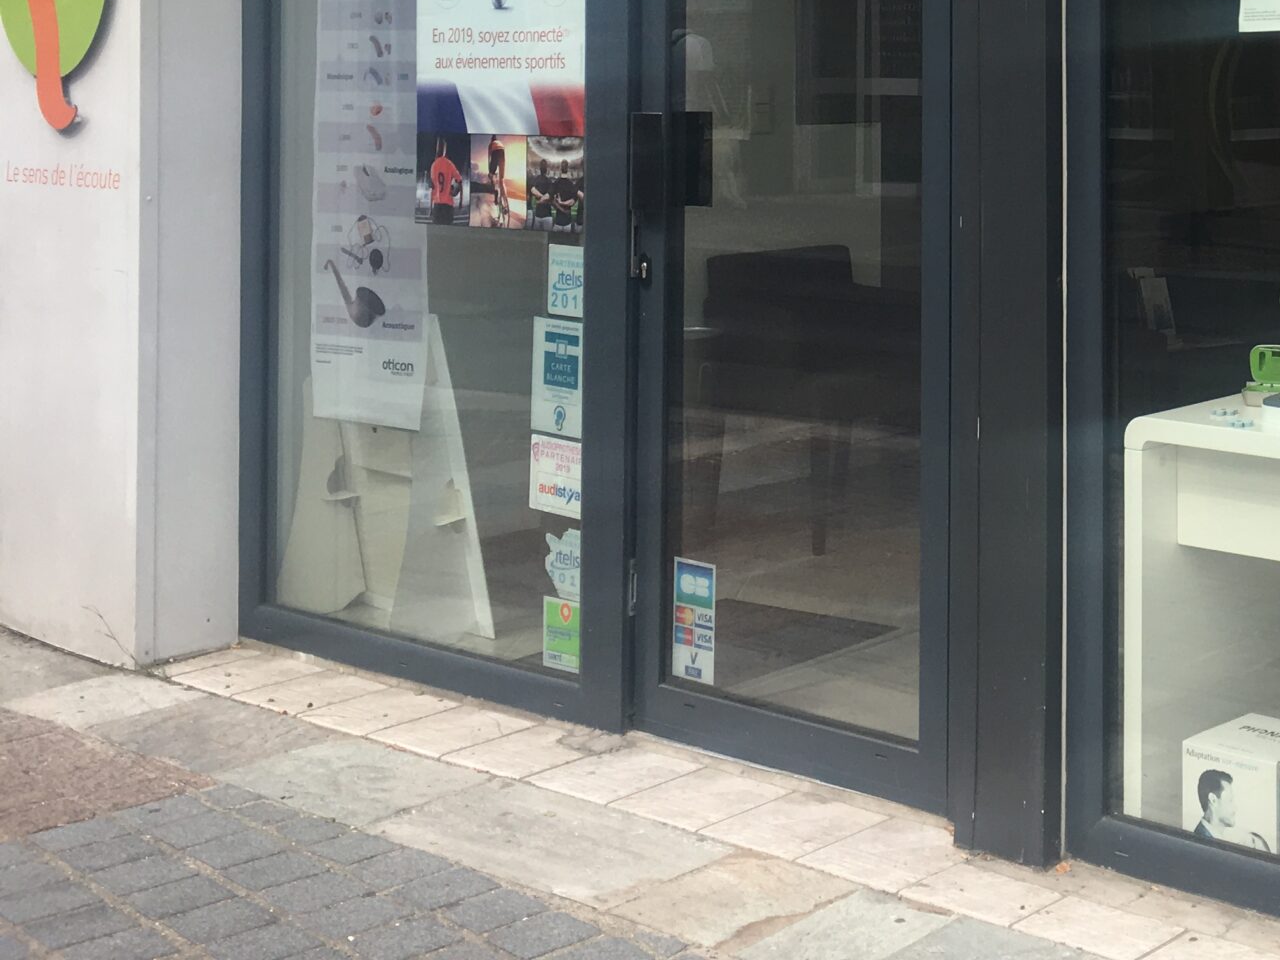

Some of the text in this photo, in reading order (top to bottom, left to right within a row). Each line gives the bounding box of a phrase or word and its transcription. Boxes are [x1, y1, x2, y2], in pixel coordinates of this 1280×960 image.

[432, 25, 563, 47] En 2019, soyez connecté
[435, 52, 565, 72] aux événements sportifs
[6, 160, 121, 190] Le sens de l'écoute
[551, 292, 578, 309] 201
[382, 358, 414, 372] oticon
[551, 362, 572, 373] CARTE
[546, 373, 575, 385] BLANCHE
[680, 573, 709, 597] CB
[697, 613, 712, 624] VISA
[696, 633, 712, 644] VISA
[1186, 748, 1220, 763] Adaptation
